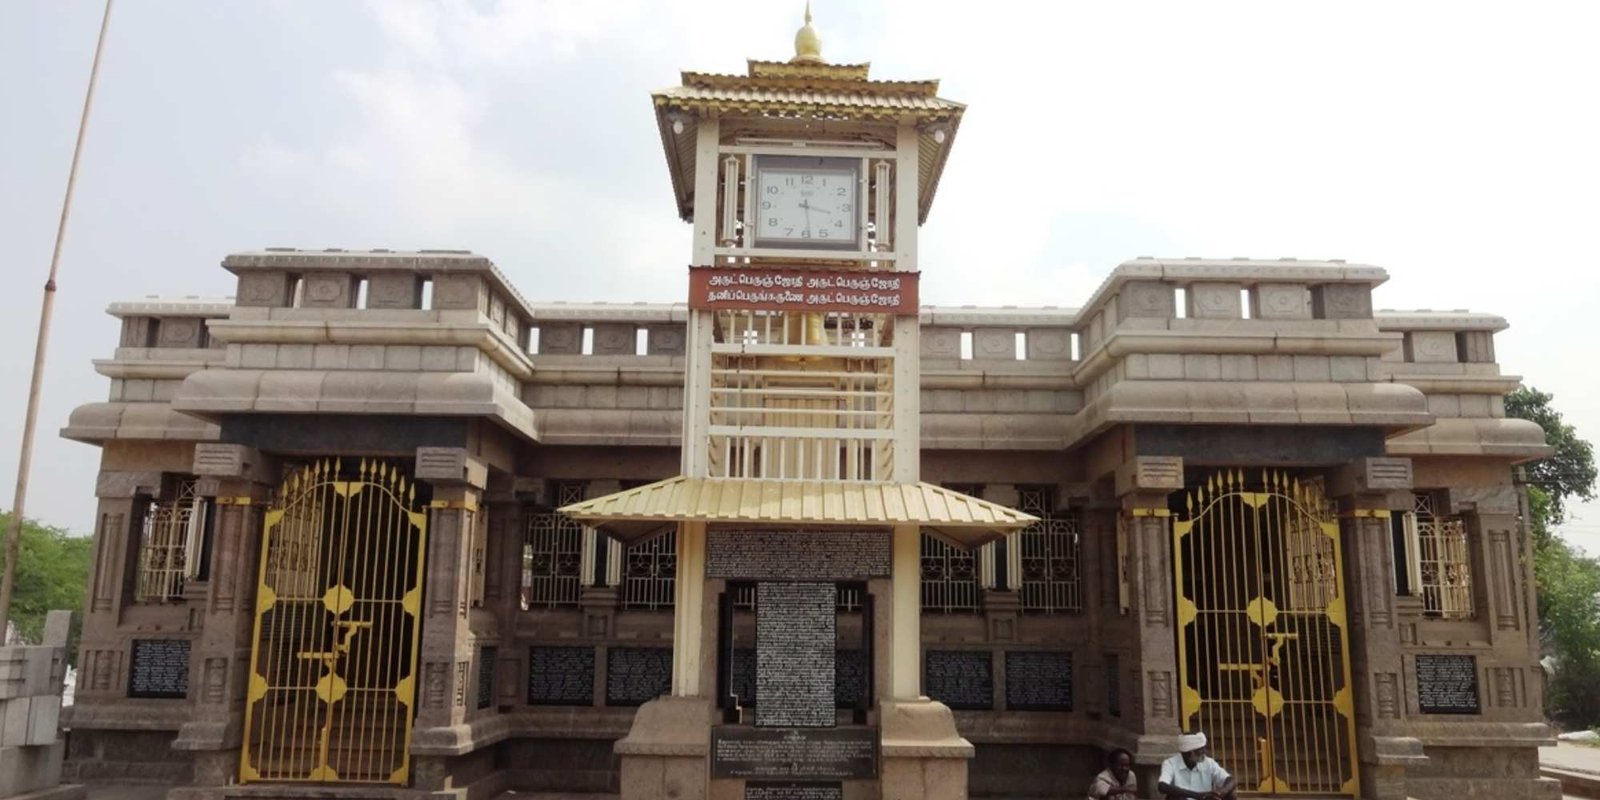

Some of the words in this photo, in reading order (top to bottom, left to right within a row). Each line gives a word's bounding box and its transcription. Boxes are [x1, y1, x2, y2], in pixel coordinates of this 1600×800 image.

[785, 177, 794, 186] 11
[801, 175, 814, 185] 12
[766, 185, 779, 194] 10
[836, 187, 847, 196] 2
[762, 201, 772, 210] 9
[841, 203, 851, 213] 3
[768, 218, 778, 227] 8
[834, 220, 843, 228] 4
[784, 228, 794, 236] 7
[801, 230, 811, 239] 6
[818, 229, 828, 238] 5
